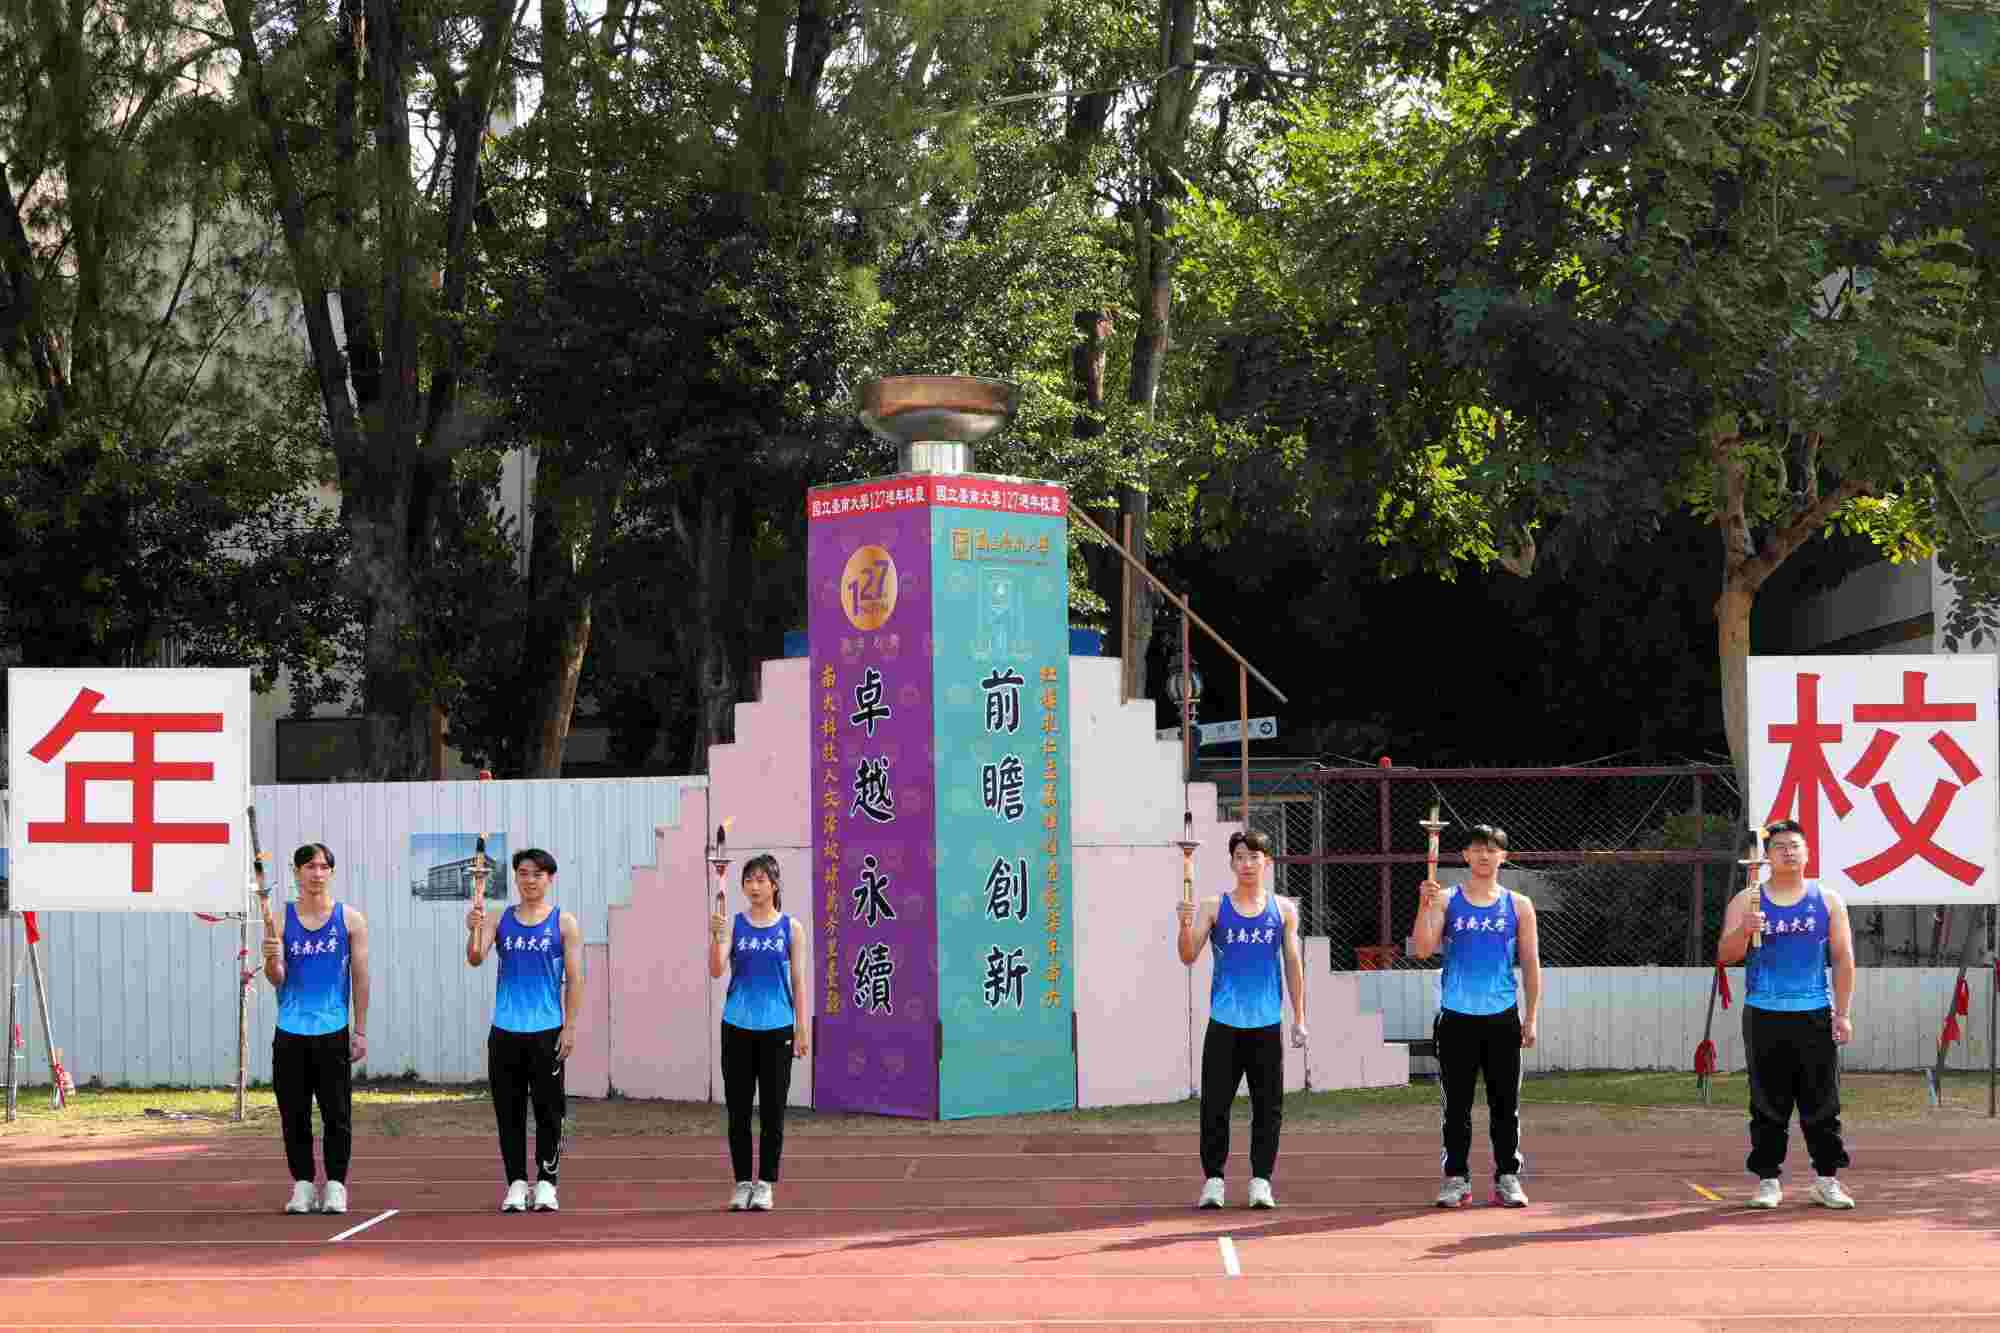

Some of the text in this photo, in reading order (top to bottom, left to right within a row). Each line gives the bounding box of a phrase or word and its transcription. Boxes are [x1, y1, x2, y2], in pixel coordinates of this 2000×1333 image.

[848, 559, 889, 616] 127
[28, 686, 230, 893] 年
[851, 667, 897, 1015] 卓越永續
[981, 667, 1030, 1008] 前瞻創新
[1765, 670, 1985, 887] 校
